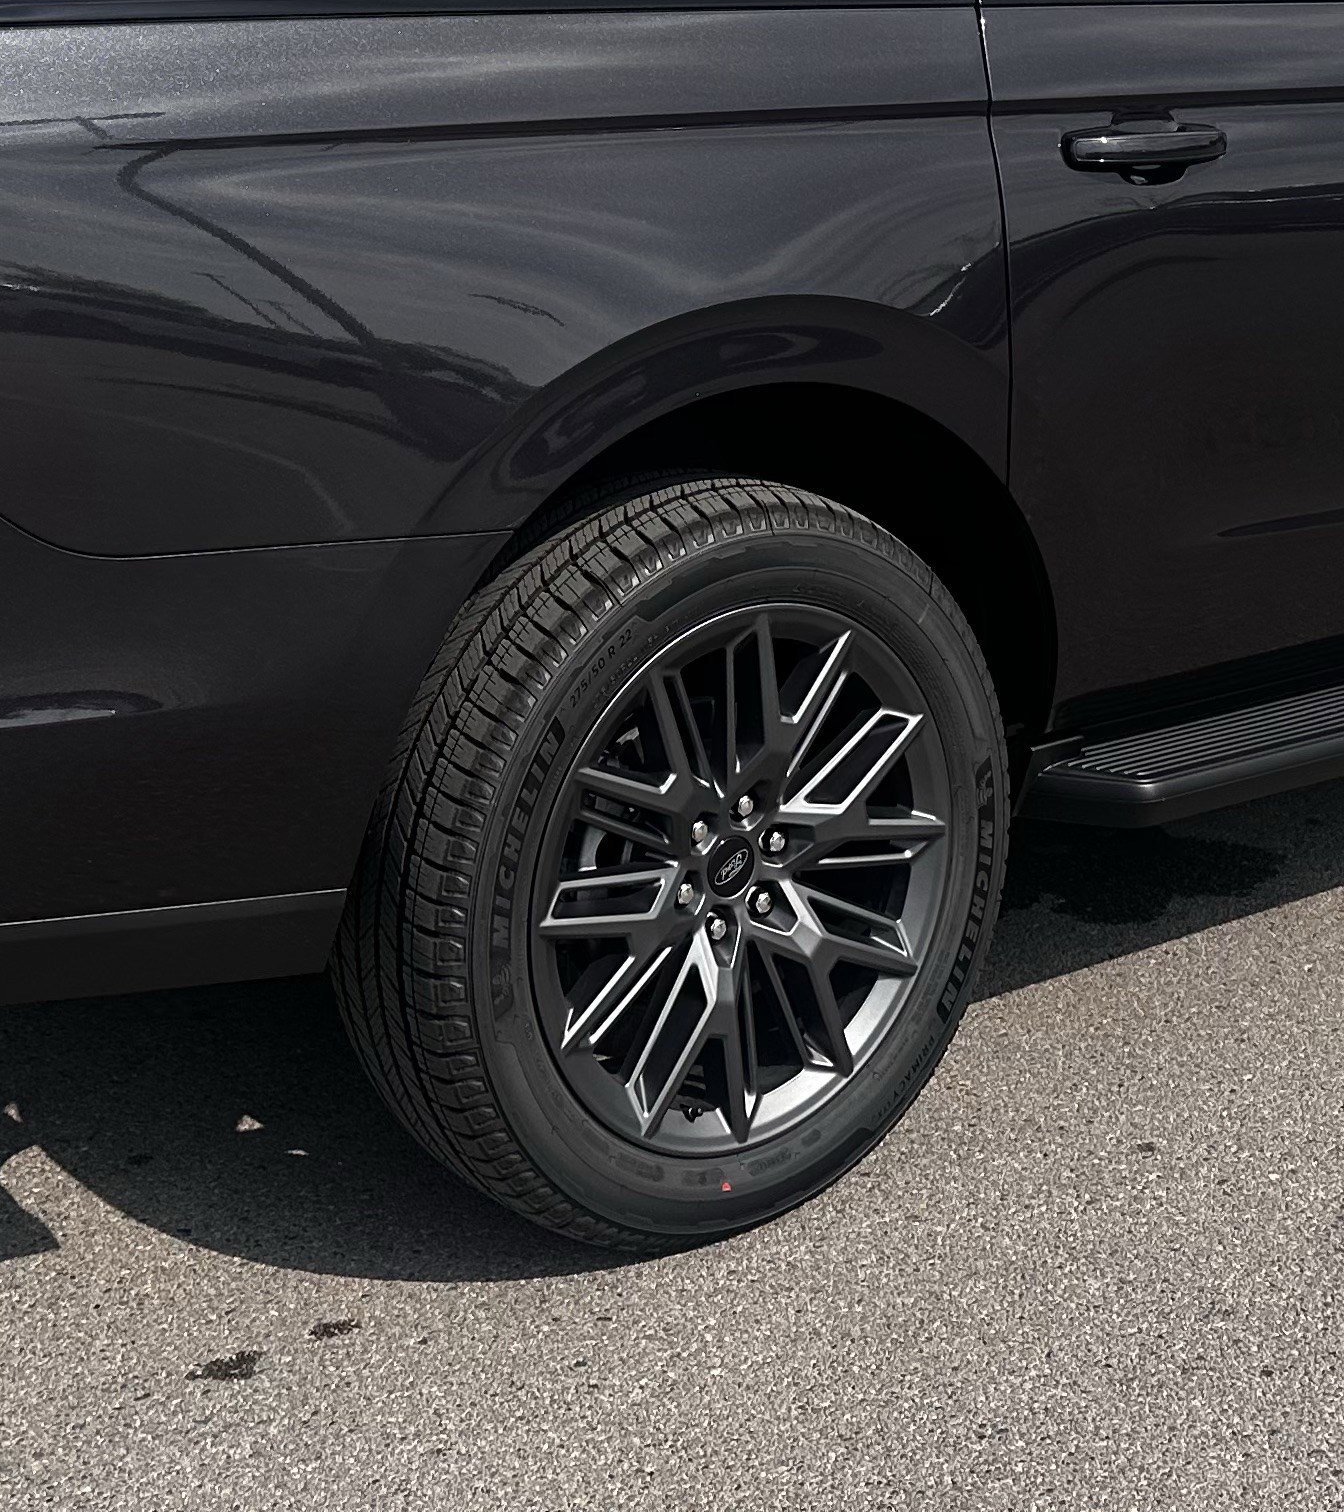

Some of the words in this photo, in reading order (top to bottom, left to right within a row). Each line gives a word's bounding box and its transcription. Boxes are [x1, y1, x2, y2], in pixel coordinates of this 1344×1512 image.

[570, 657, 606, 708] 275/50
[607, 645, 616, 659] R
[618, 628, 632, 648] 22
[492, 731, 560, 947] MICHELIN
[942, 819, 994, 1021] MICHELIN
